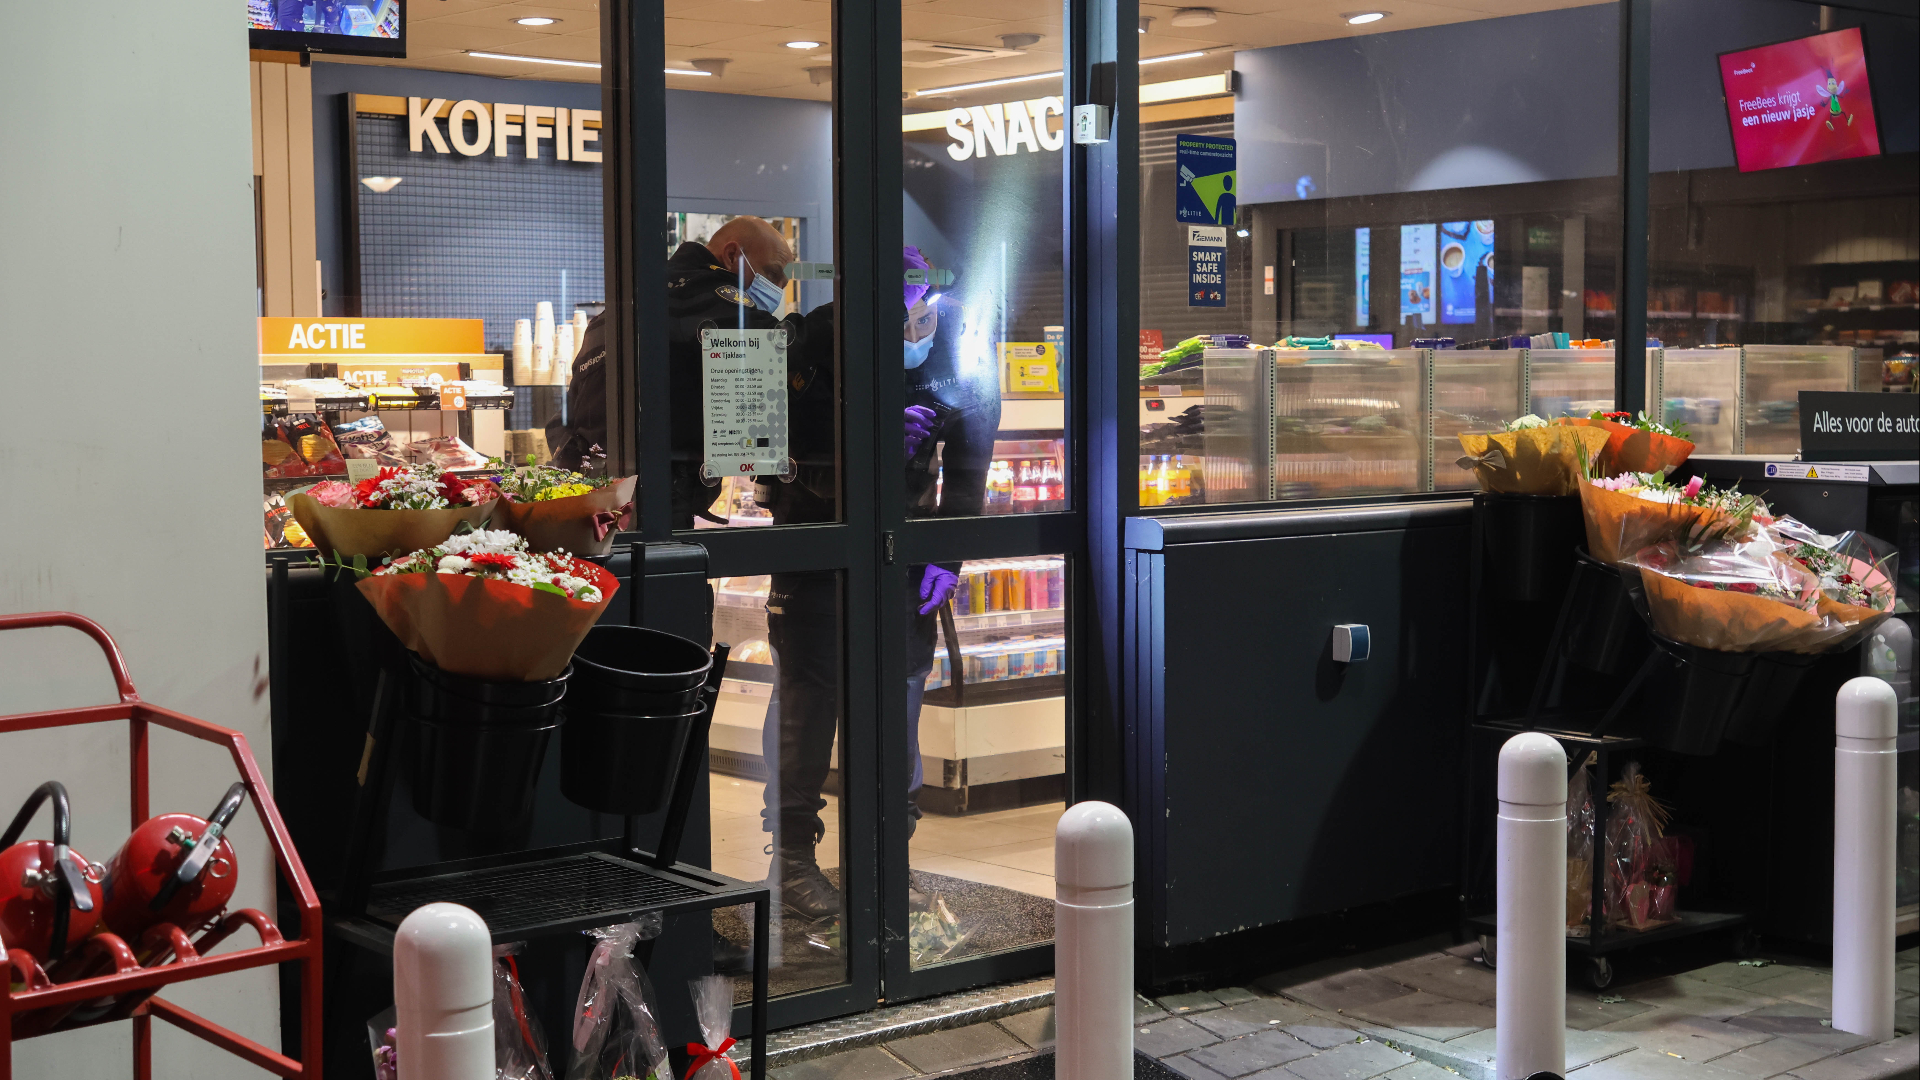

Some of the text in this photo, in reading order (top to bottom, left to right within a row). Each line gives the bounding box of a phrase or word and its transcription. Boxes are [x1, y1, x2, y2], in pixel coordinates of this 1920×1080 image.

[1739, 91, 1801, 112] FreeBees krijgt
[1742, 104, 1816, 126] een nieuw jasje
[407, 96, 603, 163] KOFFIE
[946, 96, 1064, 161] SNAC
[1179, 140, 1234, 151] PROPERTY PROTECTED
[1192, 251, 1222, 262] SMART
[1196, 263, 1218, 273] SAFE
[1192, 273, 1222, 284] INSIDE
[288, 323, 366, 350] ACTIE
[710, 337, 760, 350] Welkom bij
[722, 351, 746, 360] Tjaklaan
[343, 370, 388, 386] ACTIE
[1813, 410, 1843, 433] Alles
[1845, 416, 1874, 433] voor
[1877, 411, 1892, 433] de
[348, 431, 377, 442] Katja
[739, 463, 755, 473] OK
